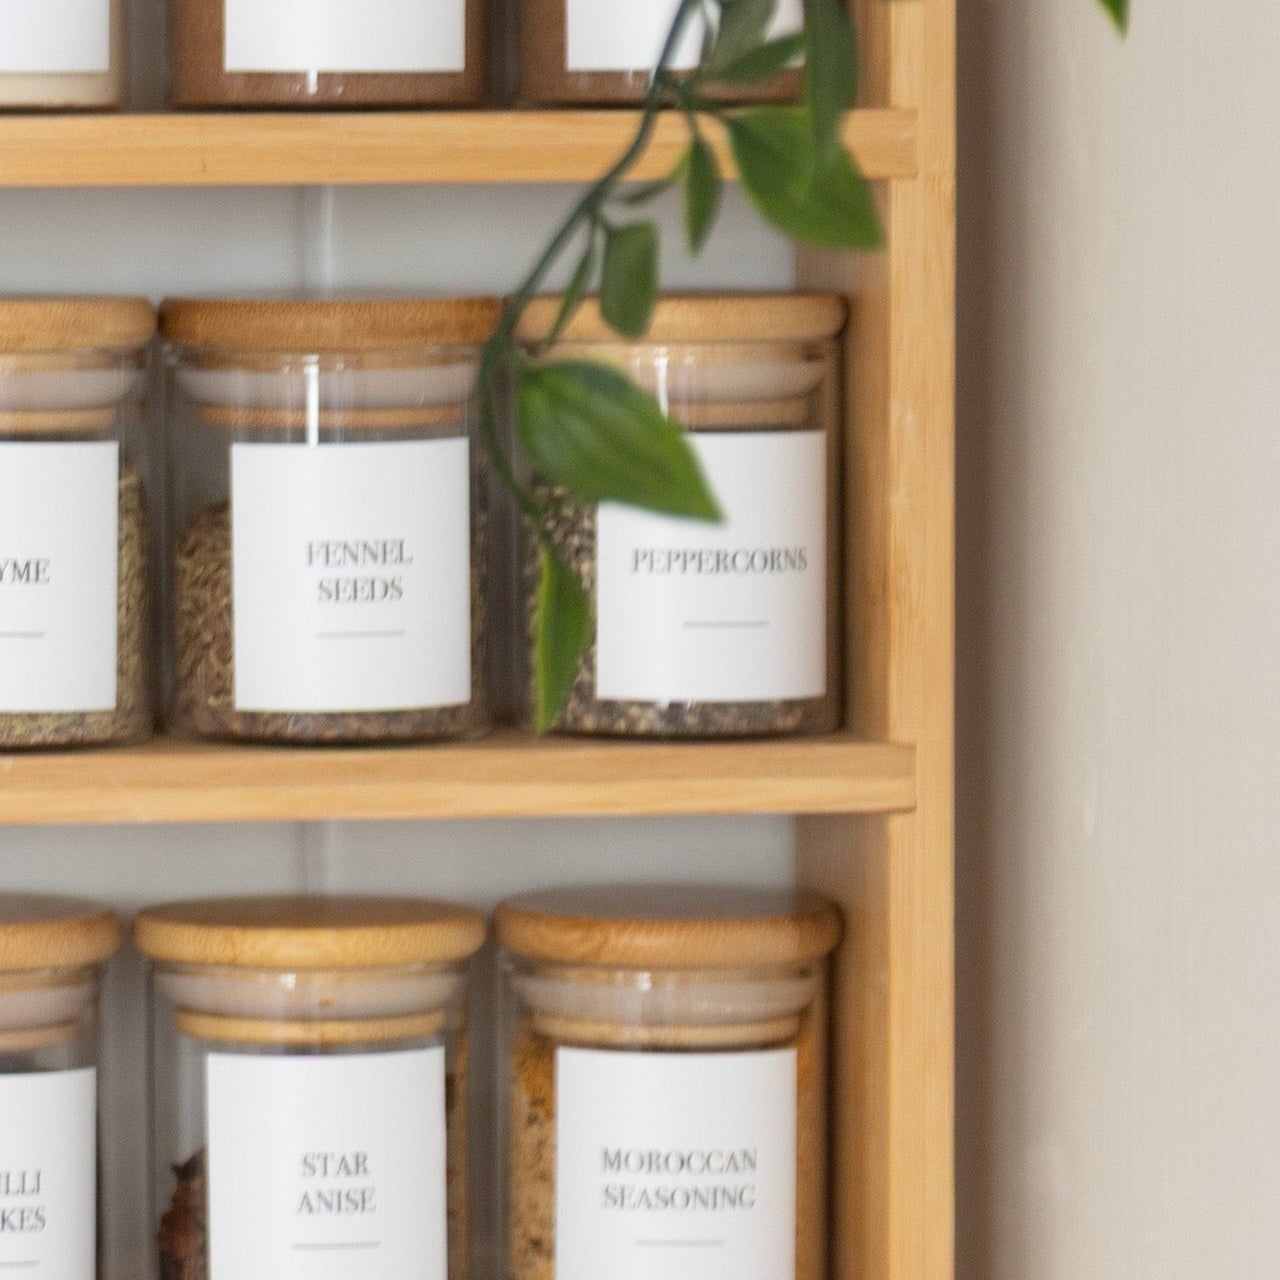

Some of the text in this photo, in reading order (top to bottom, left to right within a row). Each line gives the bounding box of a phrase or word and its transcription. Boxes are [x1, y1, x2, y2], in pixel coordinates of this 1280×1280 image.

[308, 538, 414, 566] FENNEL
[631, 547, 809, 575] PEPPERCORNS
[318, 577, 404, 603] SEEDS
[302, 1151, 369, 1178] STAR
[603, 1148, 758, 1174] MOROCCAN
[298, 1187, 377, 1214] ANISE
[603, 1183, 757, 1211] SEASONING
